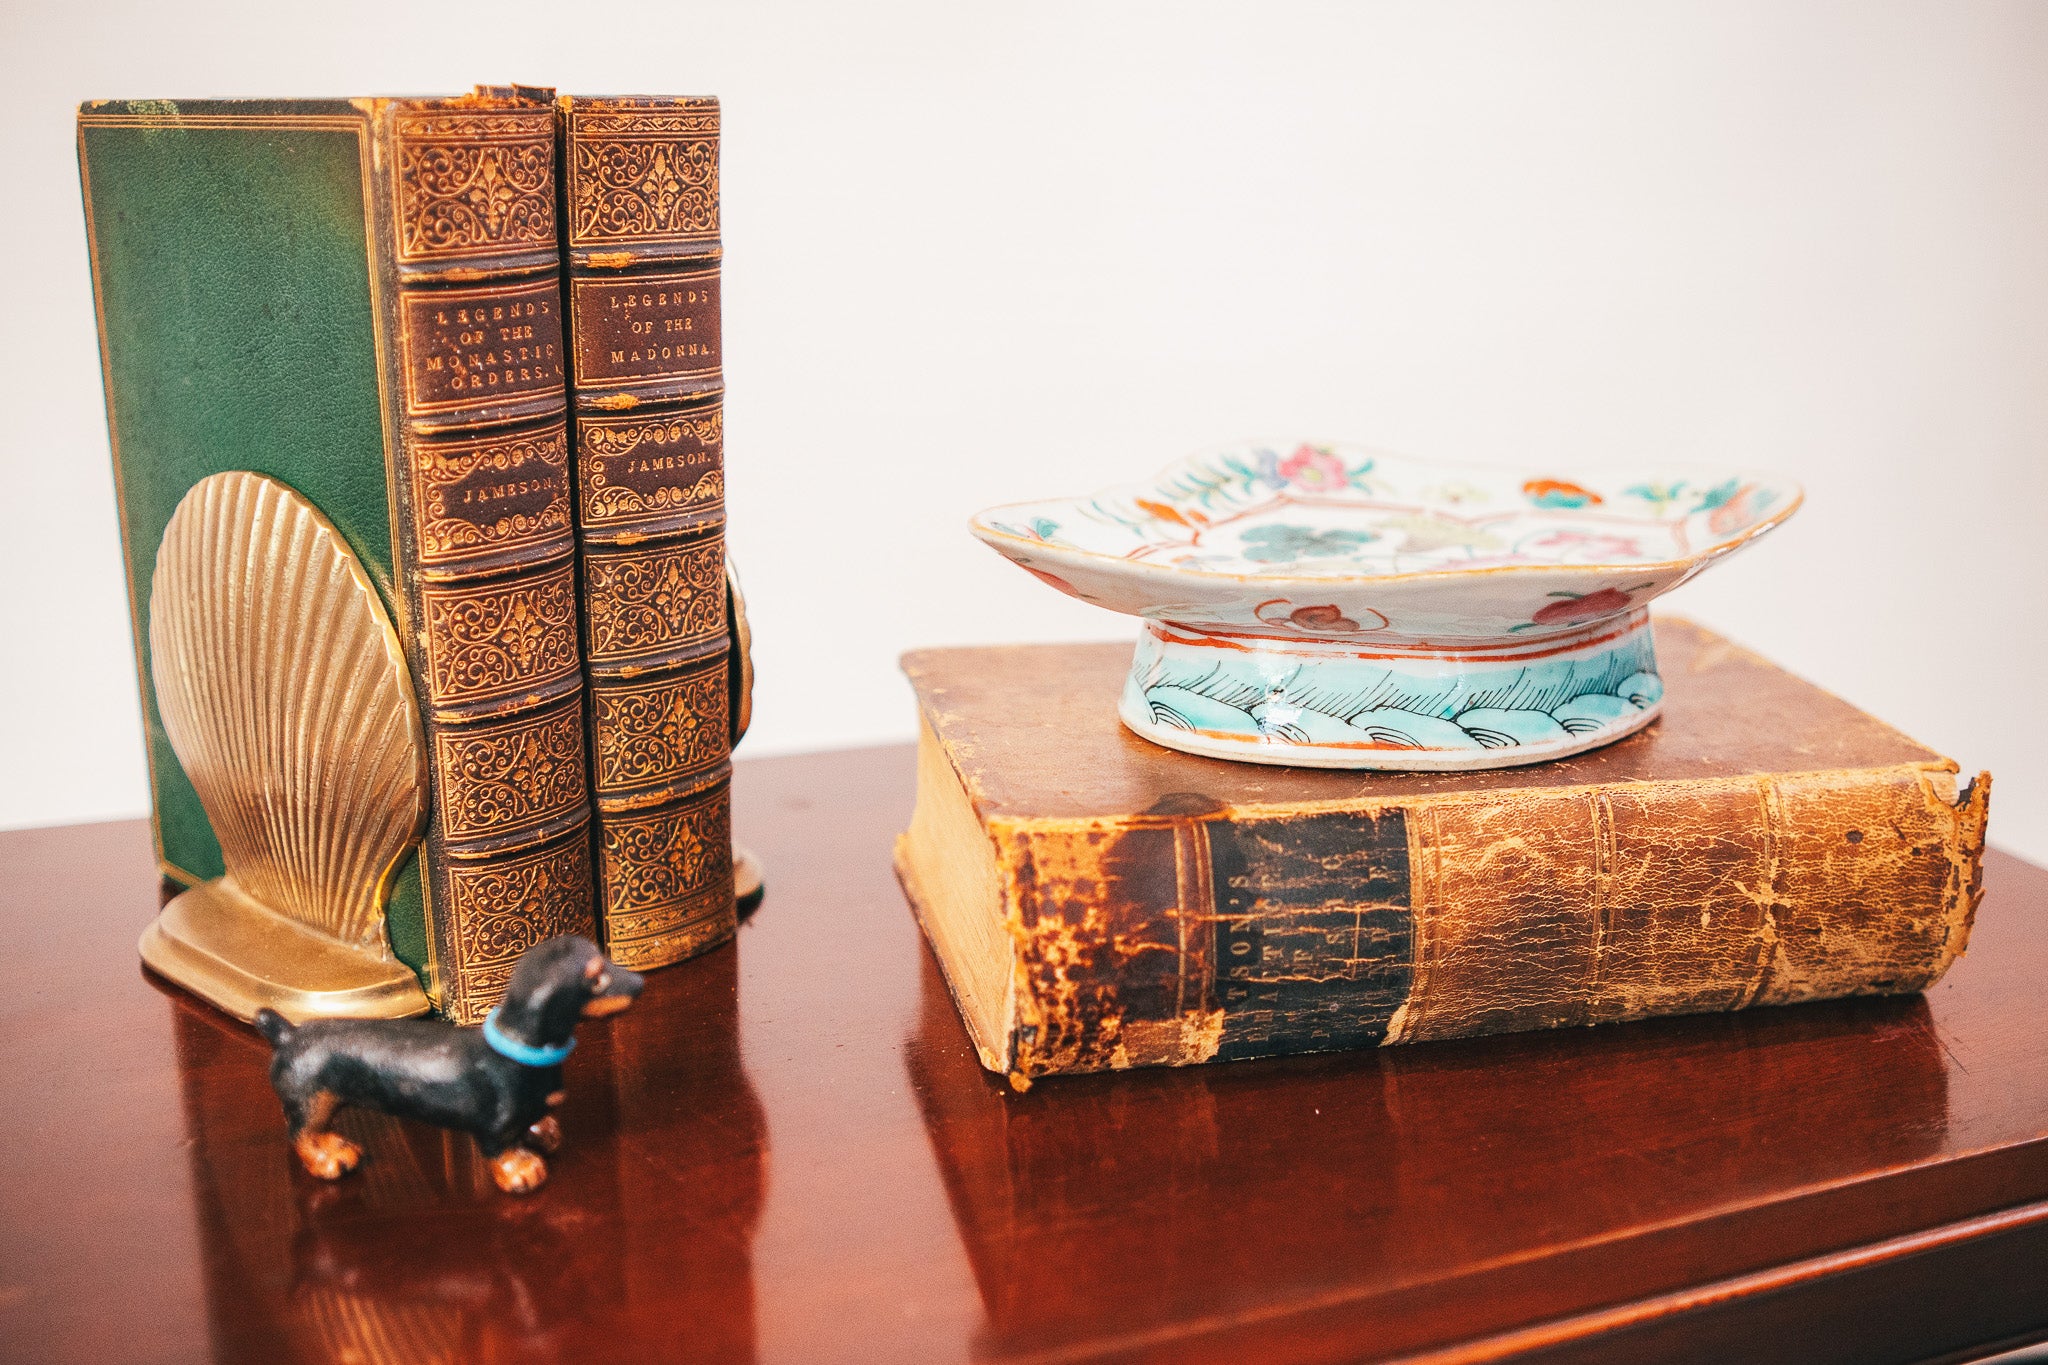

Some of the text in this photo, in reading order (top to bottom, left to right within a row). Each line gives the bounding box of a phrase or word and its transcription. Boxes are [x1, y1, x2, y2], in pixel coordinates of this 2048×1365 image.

[610, 290, 709, 309] LEGENDS
[437, 301, 549, 325] LEGENDS
[460, 325, 533, 345] OF THE
[632, 317, 693, 334] OF THE
[426, 343, 554, 371] MONASTIC
[611, 343, 715, 364] MADONNA.
